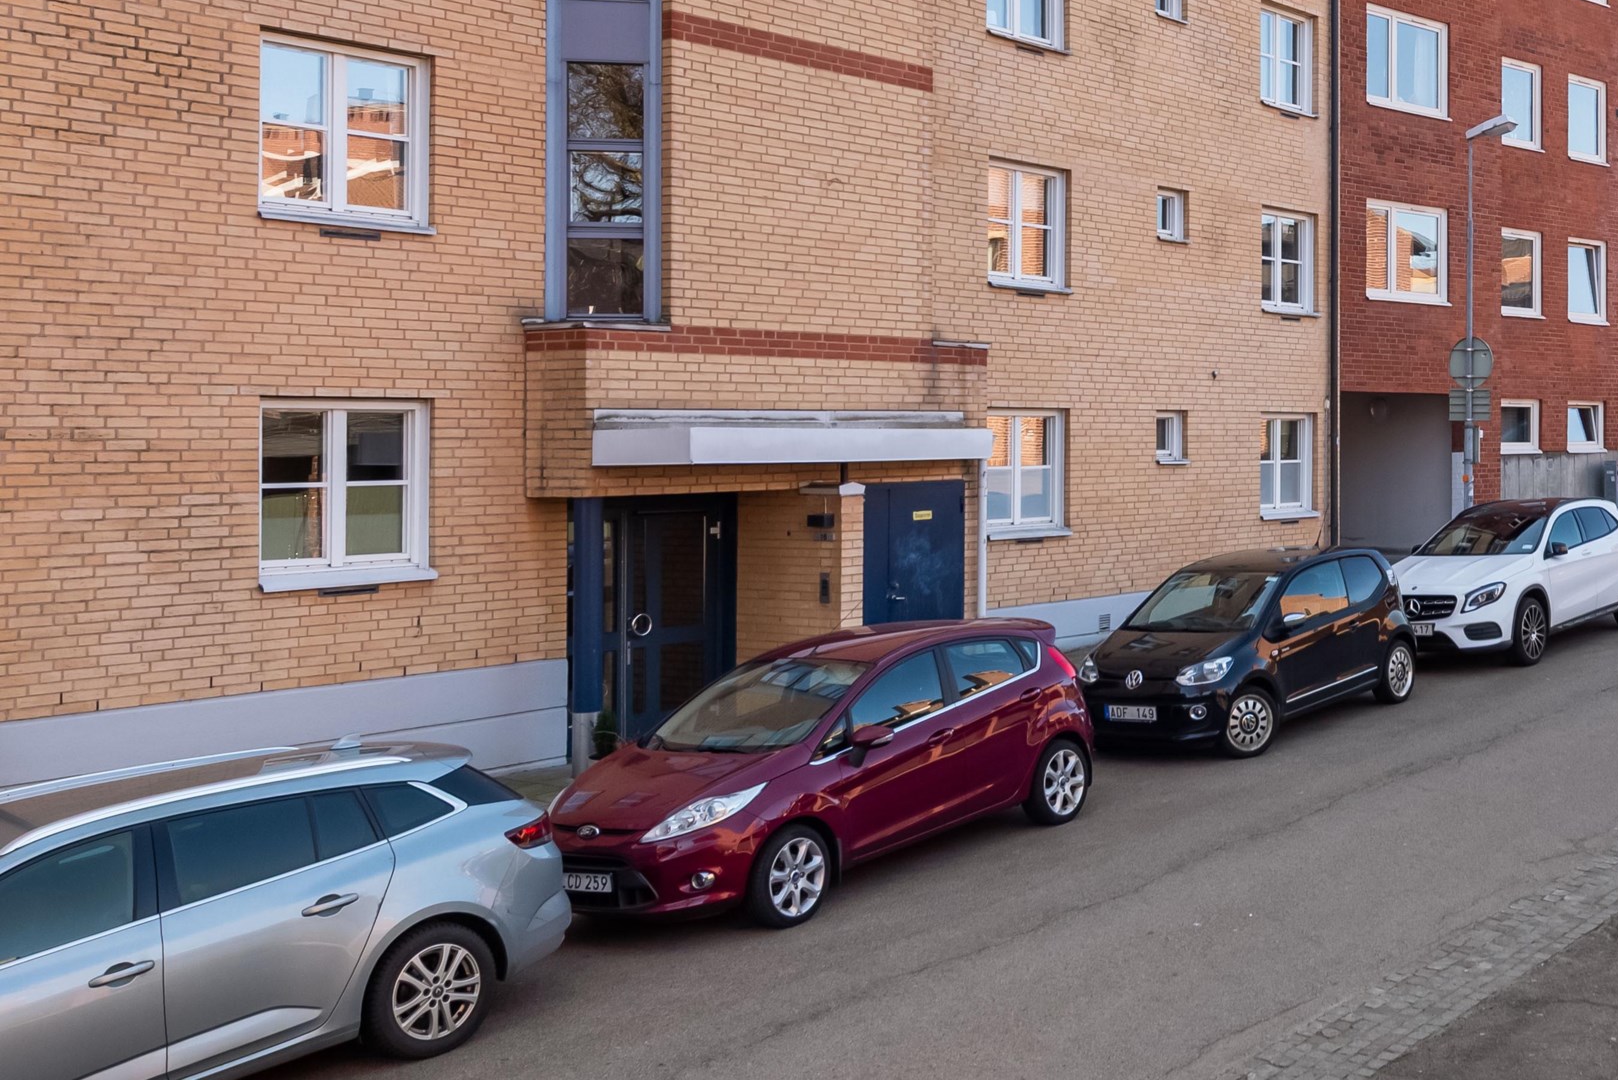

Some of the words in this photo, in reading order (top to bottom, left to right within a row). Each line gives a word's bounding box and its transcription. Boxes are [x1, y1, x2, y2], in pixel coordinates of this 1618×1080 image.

[1110, 706, 1128, 719] ADF
[1136, 707, 1155, 719] 149
[563, 873, 582, 889] CD
[585, 875, 608, 891] 259
